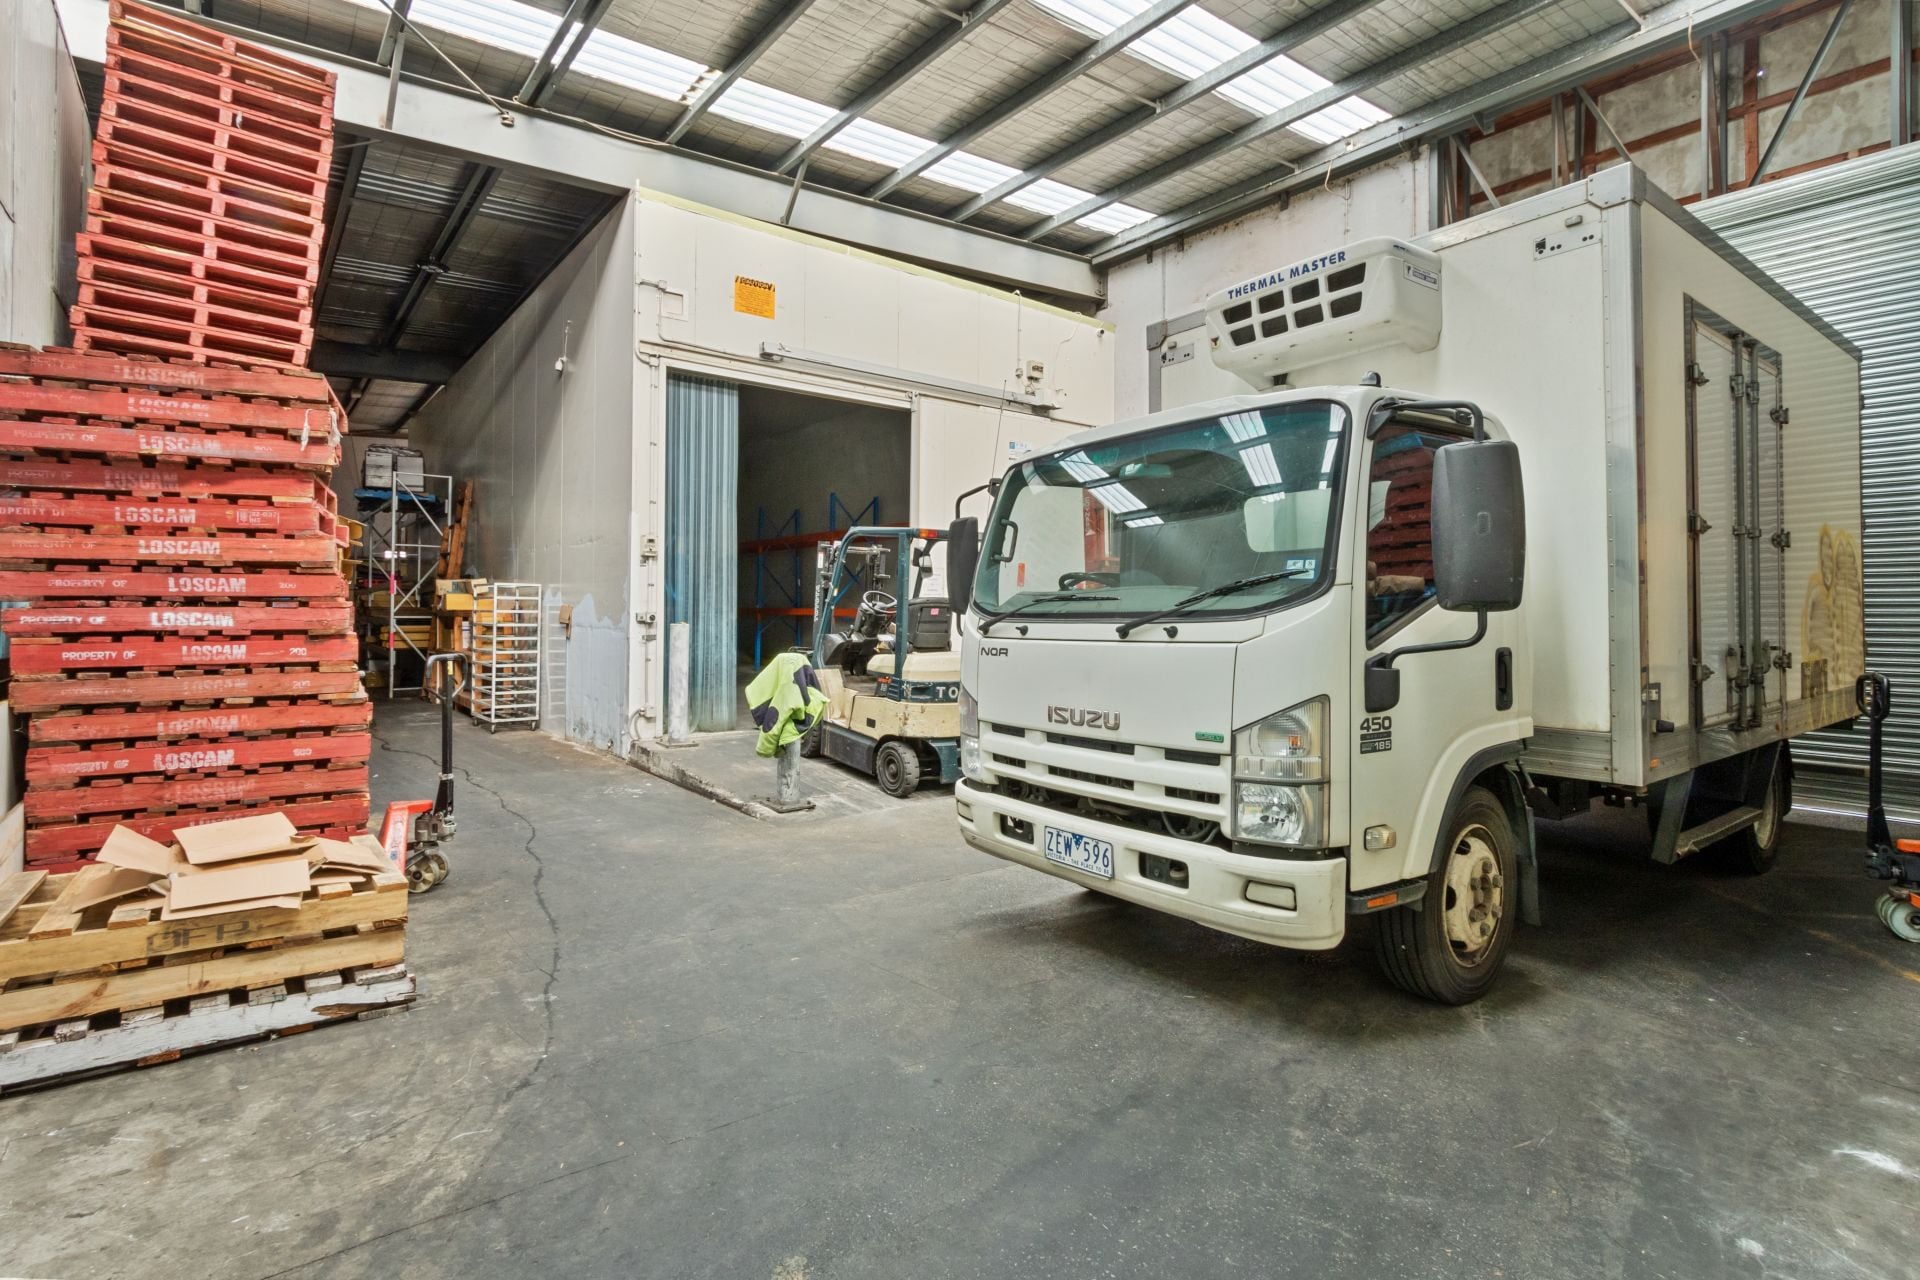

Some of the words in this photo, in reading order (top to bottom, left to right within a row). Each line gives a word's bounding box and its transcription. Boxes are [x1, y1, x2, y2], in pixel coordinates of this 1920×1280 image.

[1227, 272, 1285, 300] THERMAL
[1289, 250, 1346, 279] MASTER
[81, 433, 97, 442] OF
[139, 434, 222, 453] LOSCAM
[104, 469, 180, 490] LOSCAM
[0, 506, 45, 516] OPERTY
[114, 506, 197, 524] LOSCAM
[138, 539, 221, 555] LOSCAM
[47, 579, 106, 588] PROPERTY
[112, 579, 128, 588] OF
[168, 576, 247, 593] LOSCAM
[19, 615, 83, 625] PROPERTY
[89, 615, 107, 625] OF
[150, 611, 236, 628] LOSCAM
[61, 650, 118, 661] PROPERTY
[123, 650, 137, 661] OF
[181, 644, 248, 662] LOSCAM
[288, 647, 308, 656] 200
[980, 646, 1009, 657] NQR
[1047, 705, 1121, 731] ISUZU
[1360, 715, 1392, 733] 450
[1375, 740, 1391, 751] 185
[153, 749, 235, 771] LOSCAM
[1047, 831, 1073, 857] ZEW
[1084, 841, 1110, 868] 596
[1080, 861, 1094, 871] PLACE
